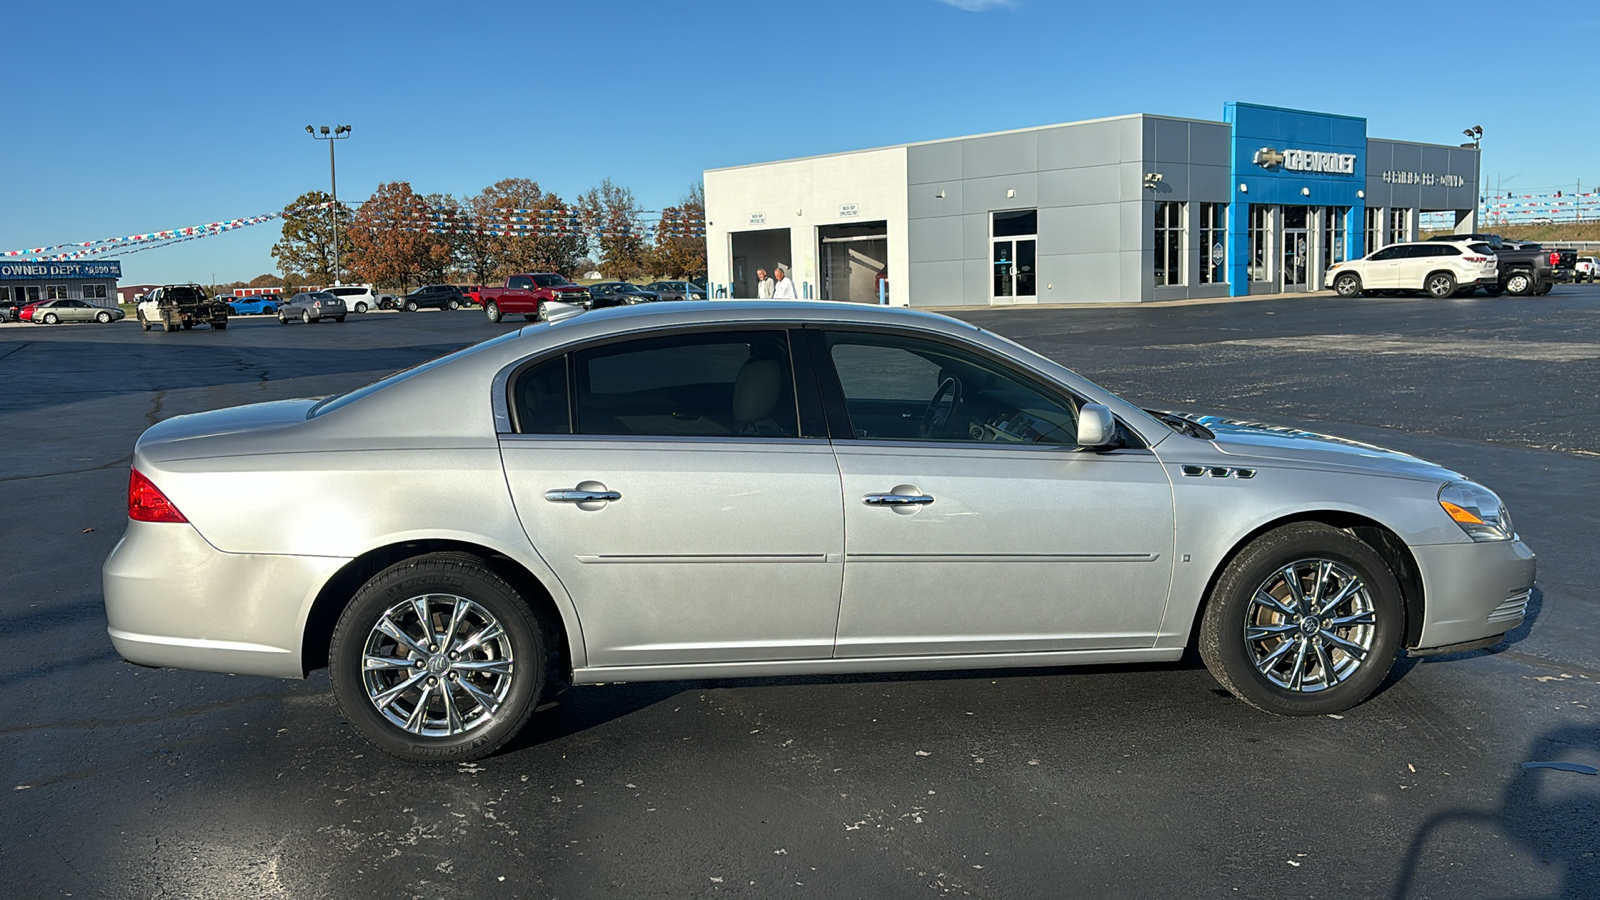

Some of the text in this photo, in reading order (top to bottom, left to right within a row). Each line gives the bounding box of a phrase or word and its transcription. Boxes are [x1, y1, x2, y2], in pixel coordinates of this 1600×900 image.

[1283, 149, 1356, 174] CHEVROLET
[2, 265, 47, 276] OWNED
[401, 576, 464, 591] MICHELIN
[414, 742, 474, 757] MICHELIN
